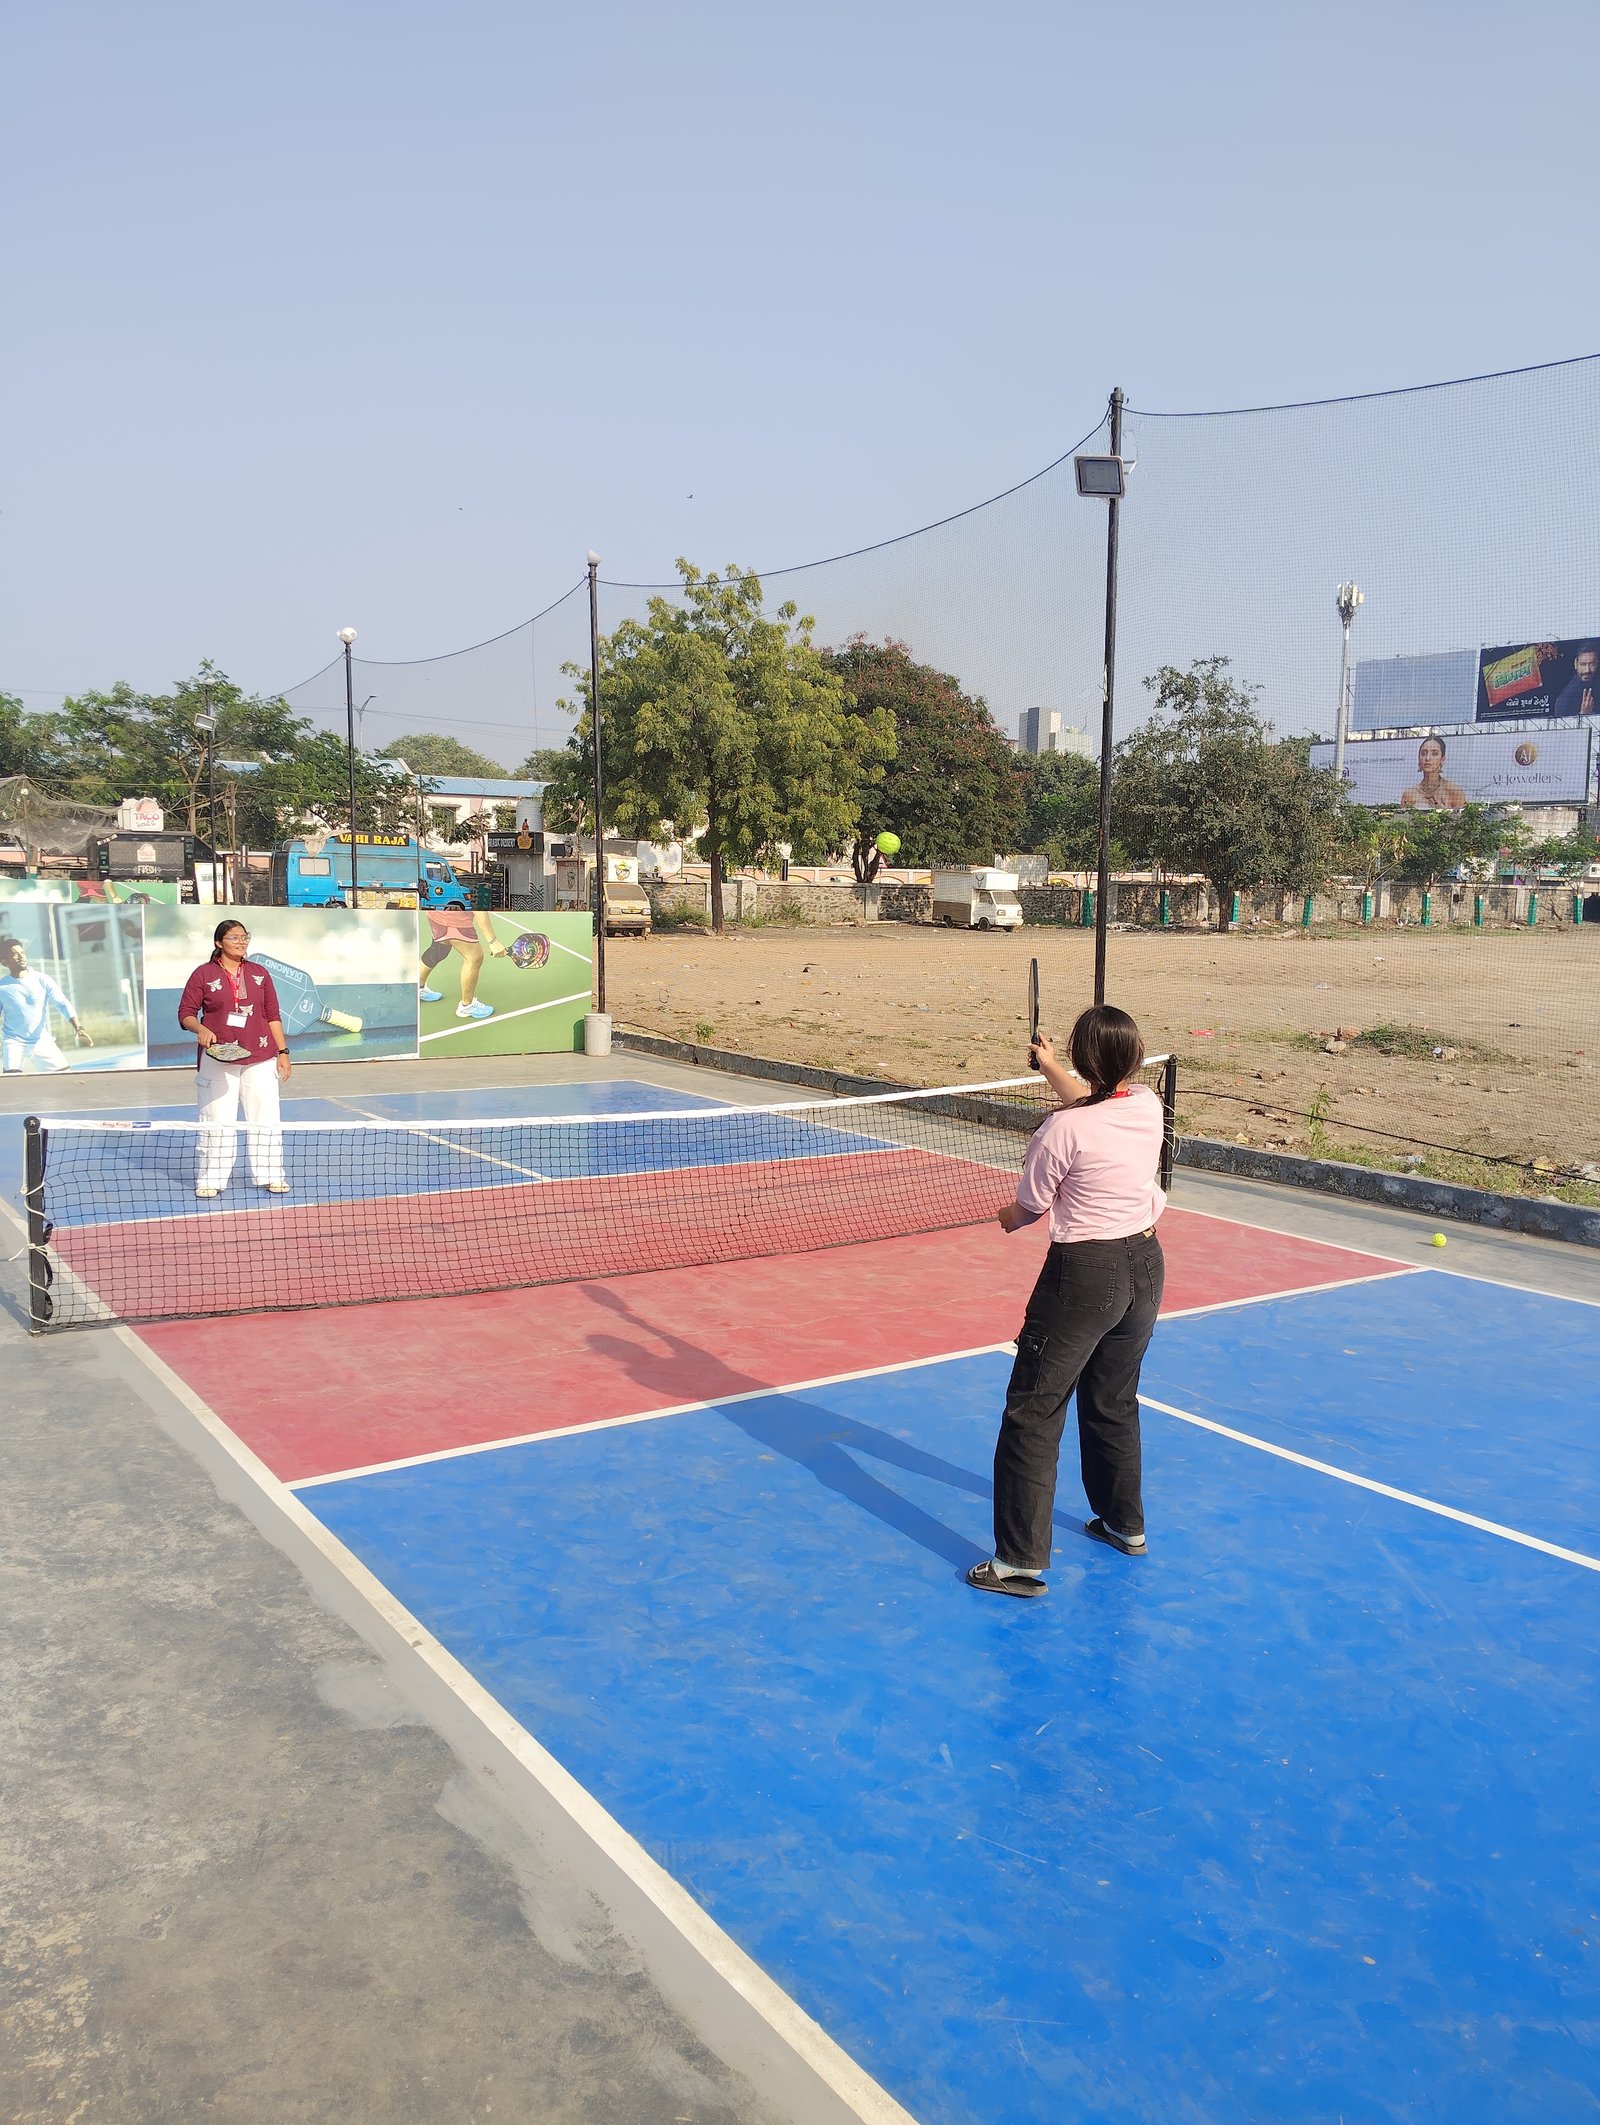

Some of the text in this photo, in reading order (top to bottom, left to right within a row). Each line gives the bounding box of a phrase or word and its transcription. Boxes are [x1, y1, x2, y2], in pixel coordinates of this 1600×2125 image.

[134, 812, 160, 821] TACO
[373, 835, 406, 846] RAJA
[265, 959, 304, 980] DIAMOND
